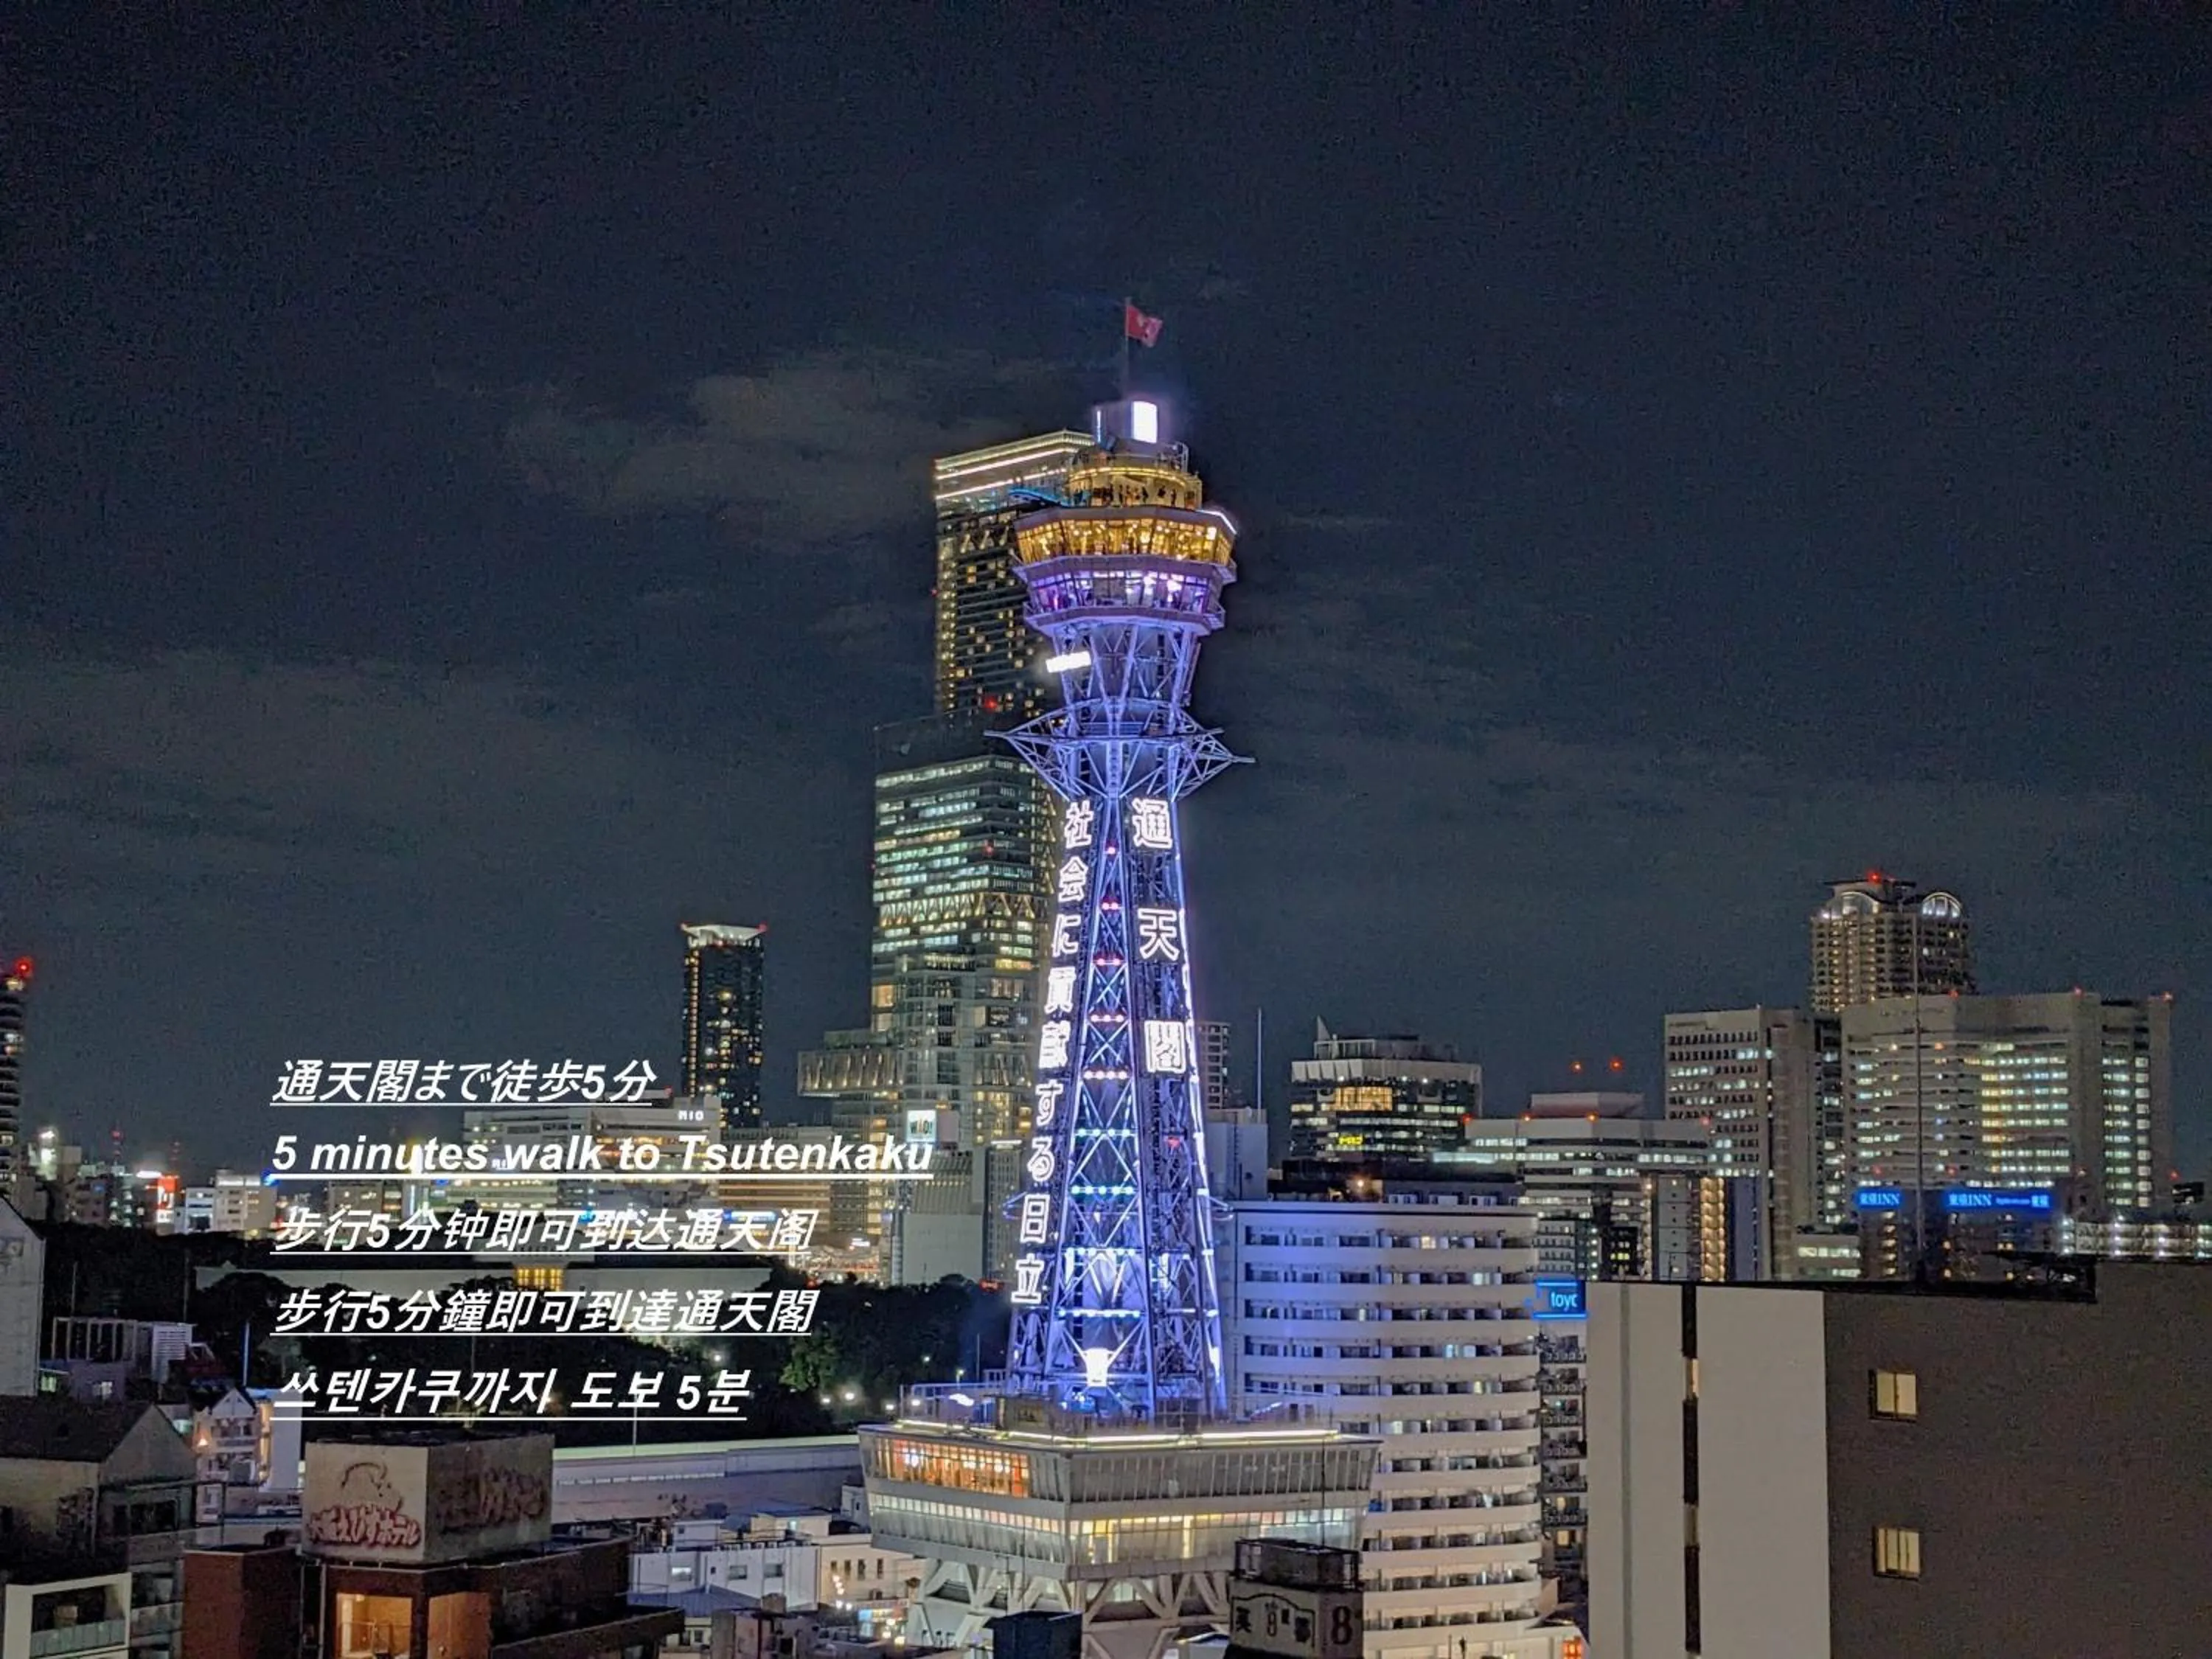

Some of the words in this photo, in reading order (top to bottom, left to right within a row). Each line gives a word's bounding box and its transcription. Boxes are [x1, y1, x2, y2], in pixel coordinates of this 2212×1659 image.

[1010, 799, 1094, 1305] 社会に貢献する日立
[1131, 799, 1187, 1074] 通天閣
[1331, 1605, 1352, 1645] 8
